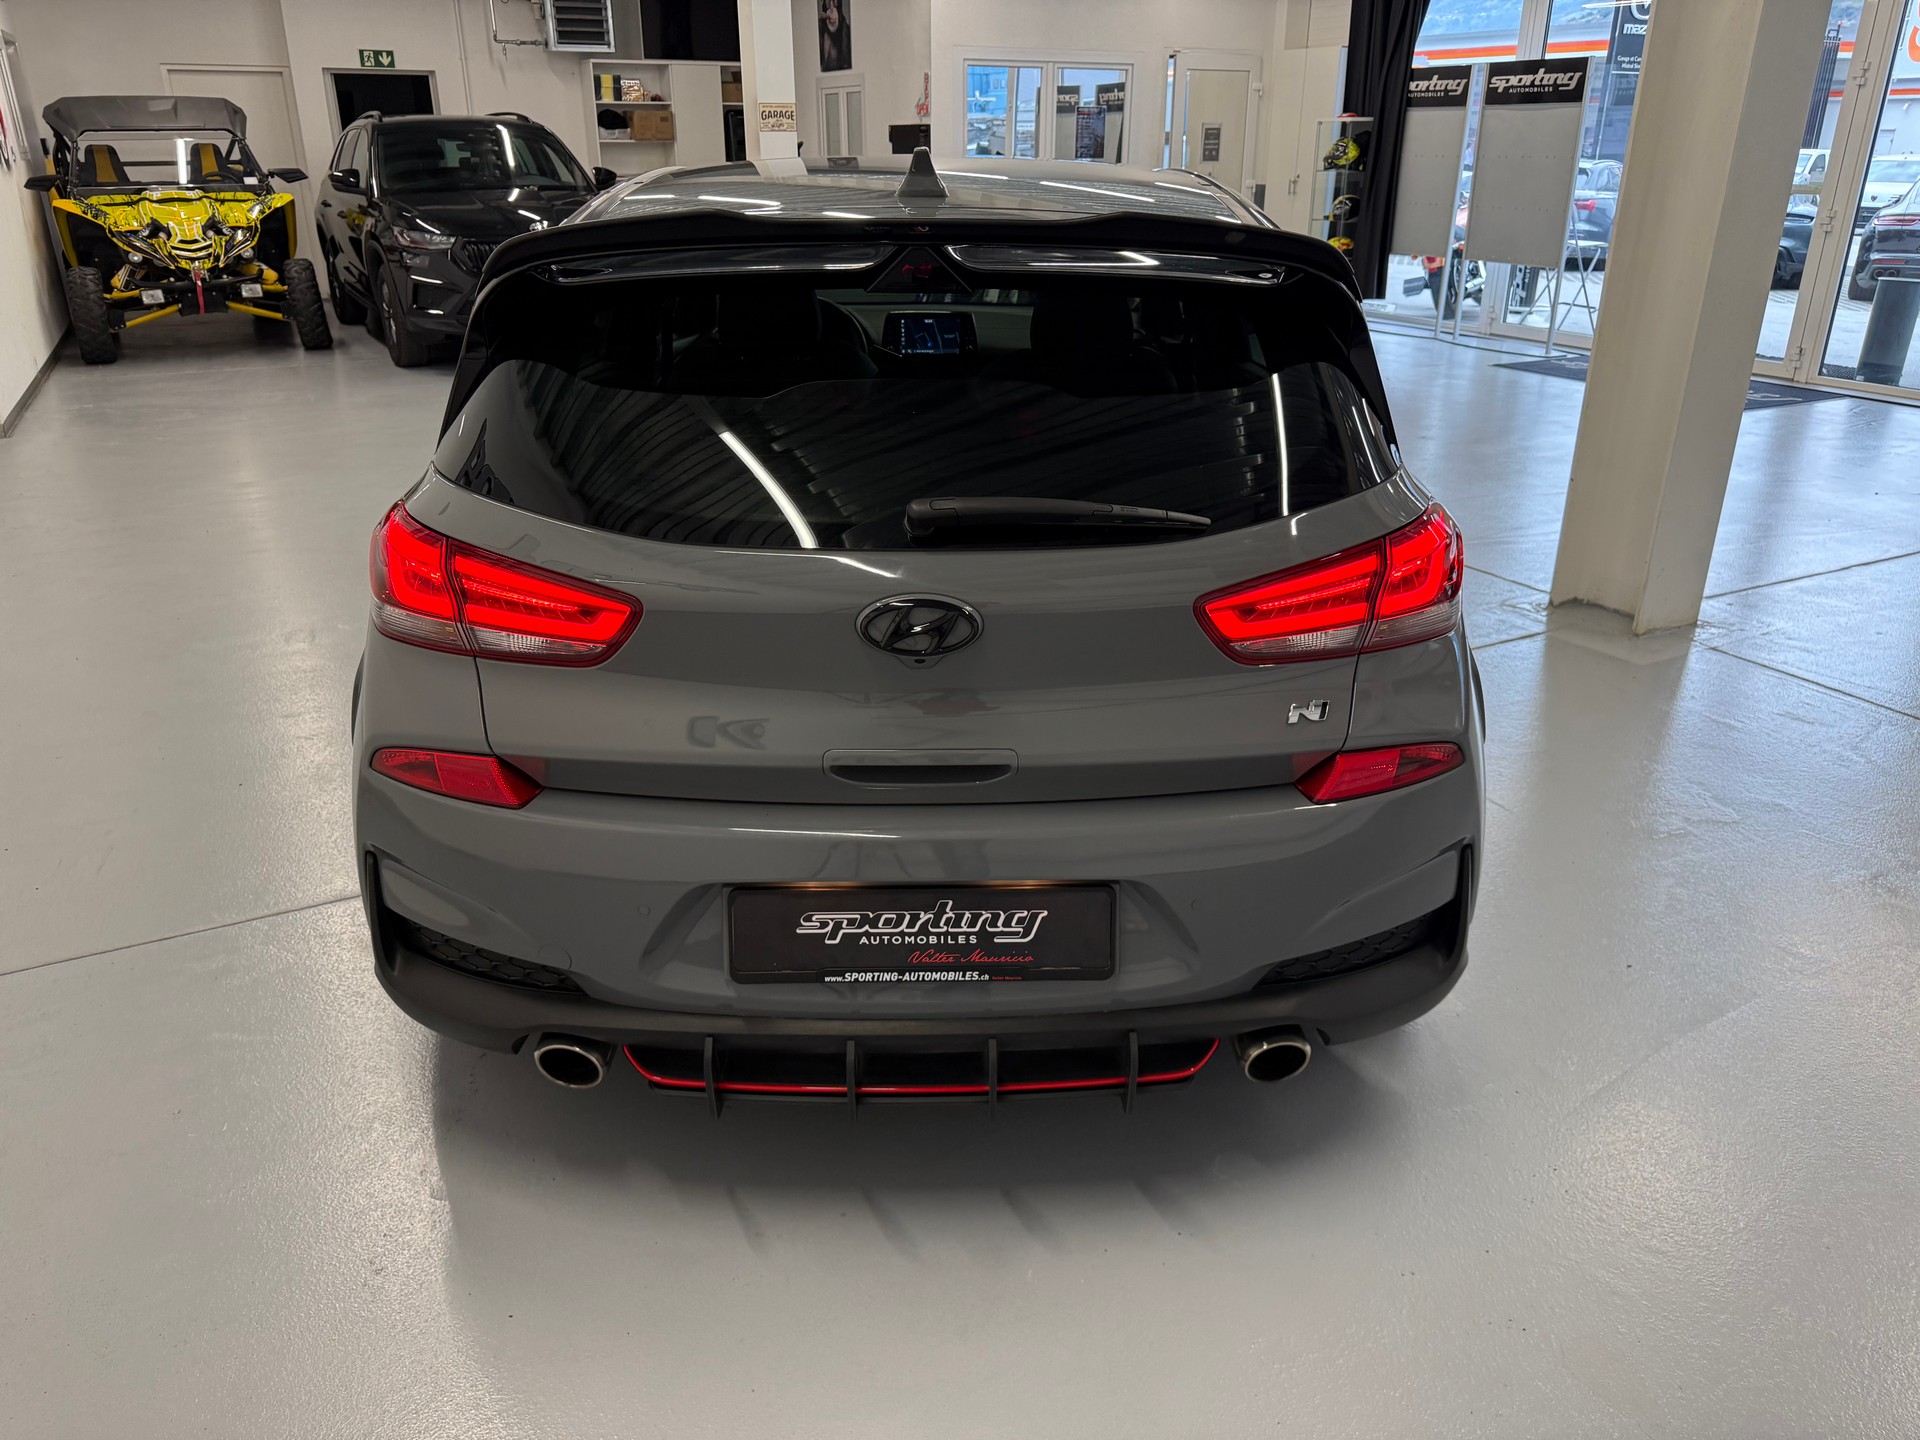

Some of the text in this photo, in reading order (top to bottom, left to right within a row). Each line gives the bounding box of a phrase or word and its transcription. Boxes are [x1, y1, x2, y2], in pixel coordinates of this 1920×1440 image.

[1623, 24, 1648, 35] maz
[1489, 68, 1583, 93] sporting
[1508, 86, 1553, 94] AUTOMOBILES
[761, 110, 795, 122] GARAGE
[1288, 699, 1330, 724] N
[796, 899, 1049, 945] sporting
[859, 935, 978, 945] AUTOMOBILES
[908, 949, 1034, 964] Valter Mauricio
[824, 971, 990, 983] www.SPORTING-AUTOMOBILES.ch
